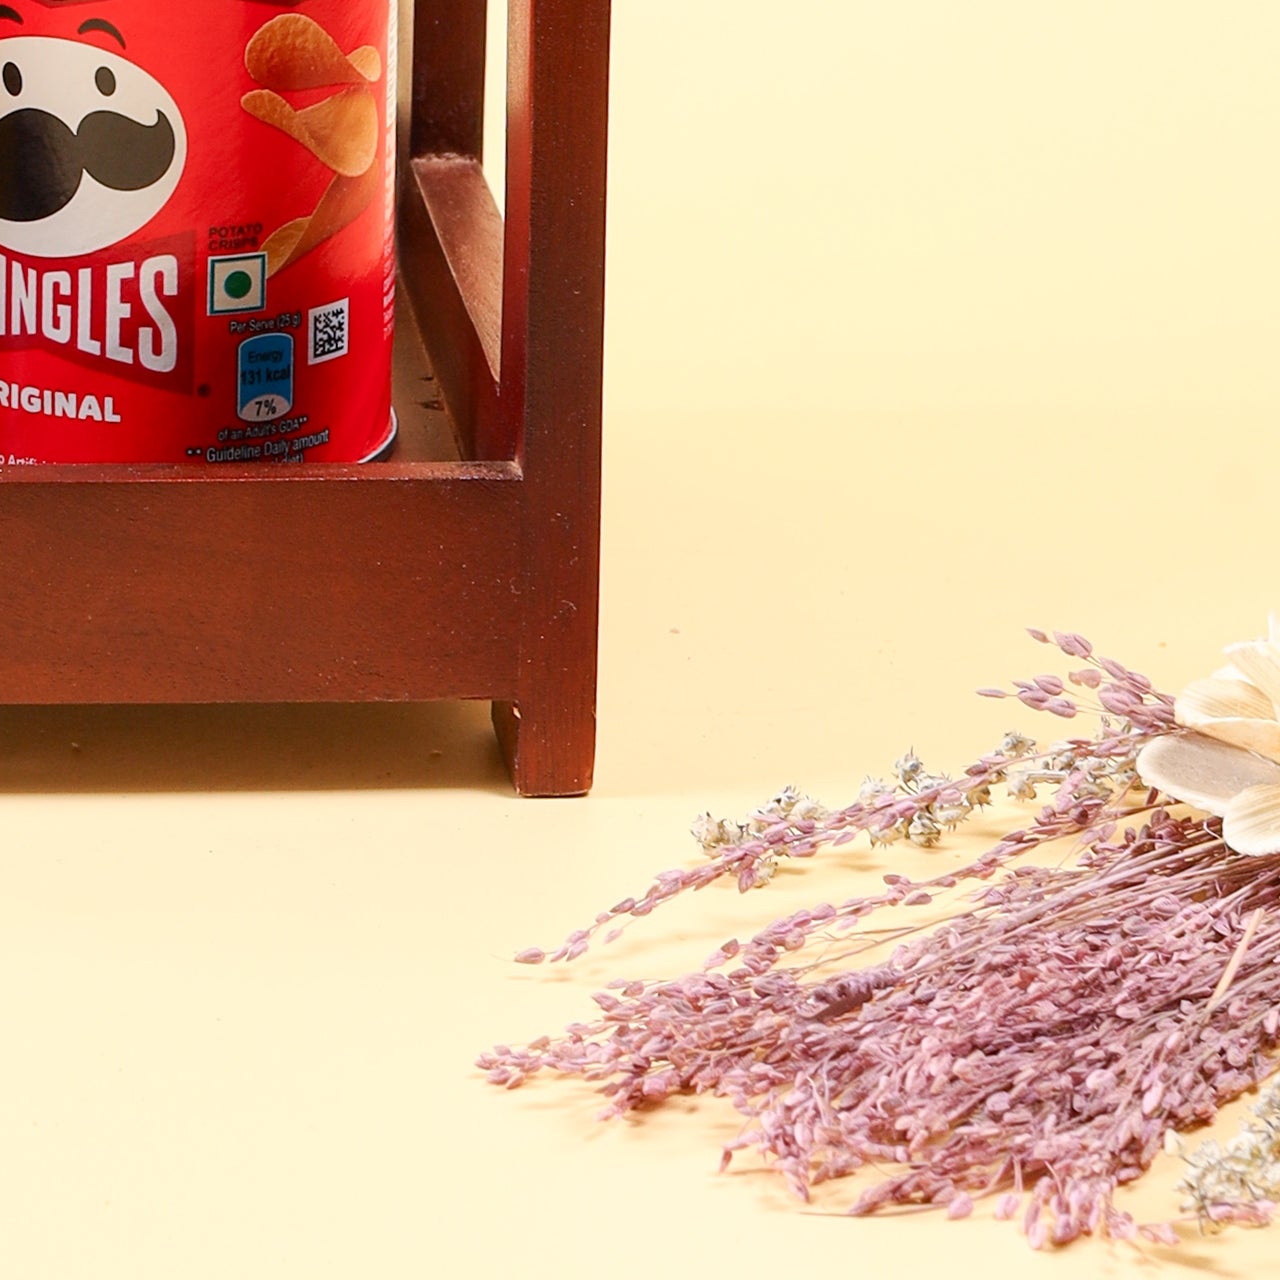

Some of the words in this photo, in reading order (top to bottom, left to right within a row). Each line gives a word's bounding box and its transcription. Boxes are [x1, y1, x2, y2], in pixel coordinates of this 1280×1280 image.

[208, 222, 263, 239] POTATO
[208, 236, 259, 252] CRISPS
[229, 320, 246, 333] Per
[248, 317, 275, 332] Serve
[247, 350, 283, 364] Energy
[240, 369, 263, 386] 131
[265, 364, 291, 382] kcal
[254, 398, 277, 416] 7%
[217, 429, 229, 441] of
[206, 445, 261, 463] Guideline
[263, 439, 290, 456] Daily
[292, 428, 330, 451] amount
